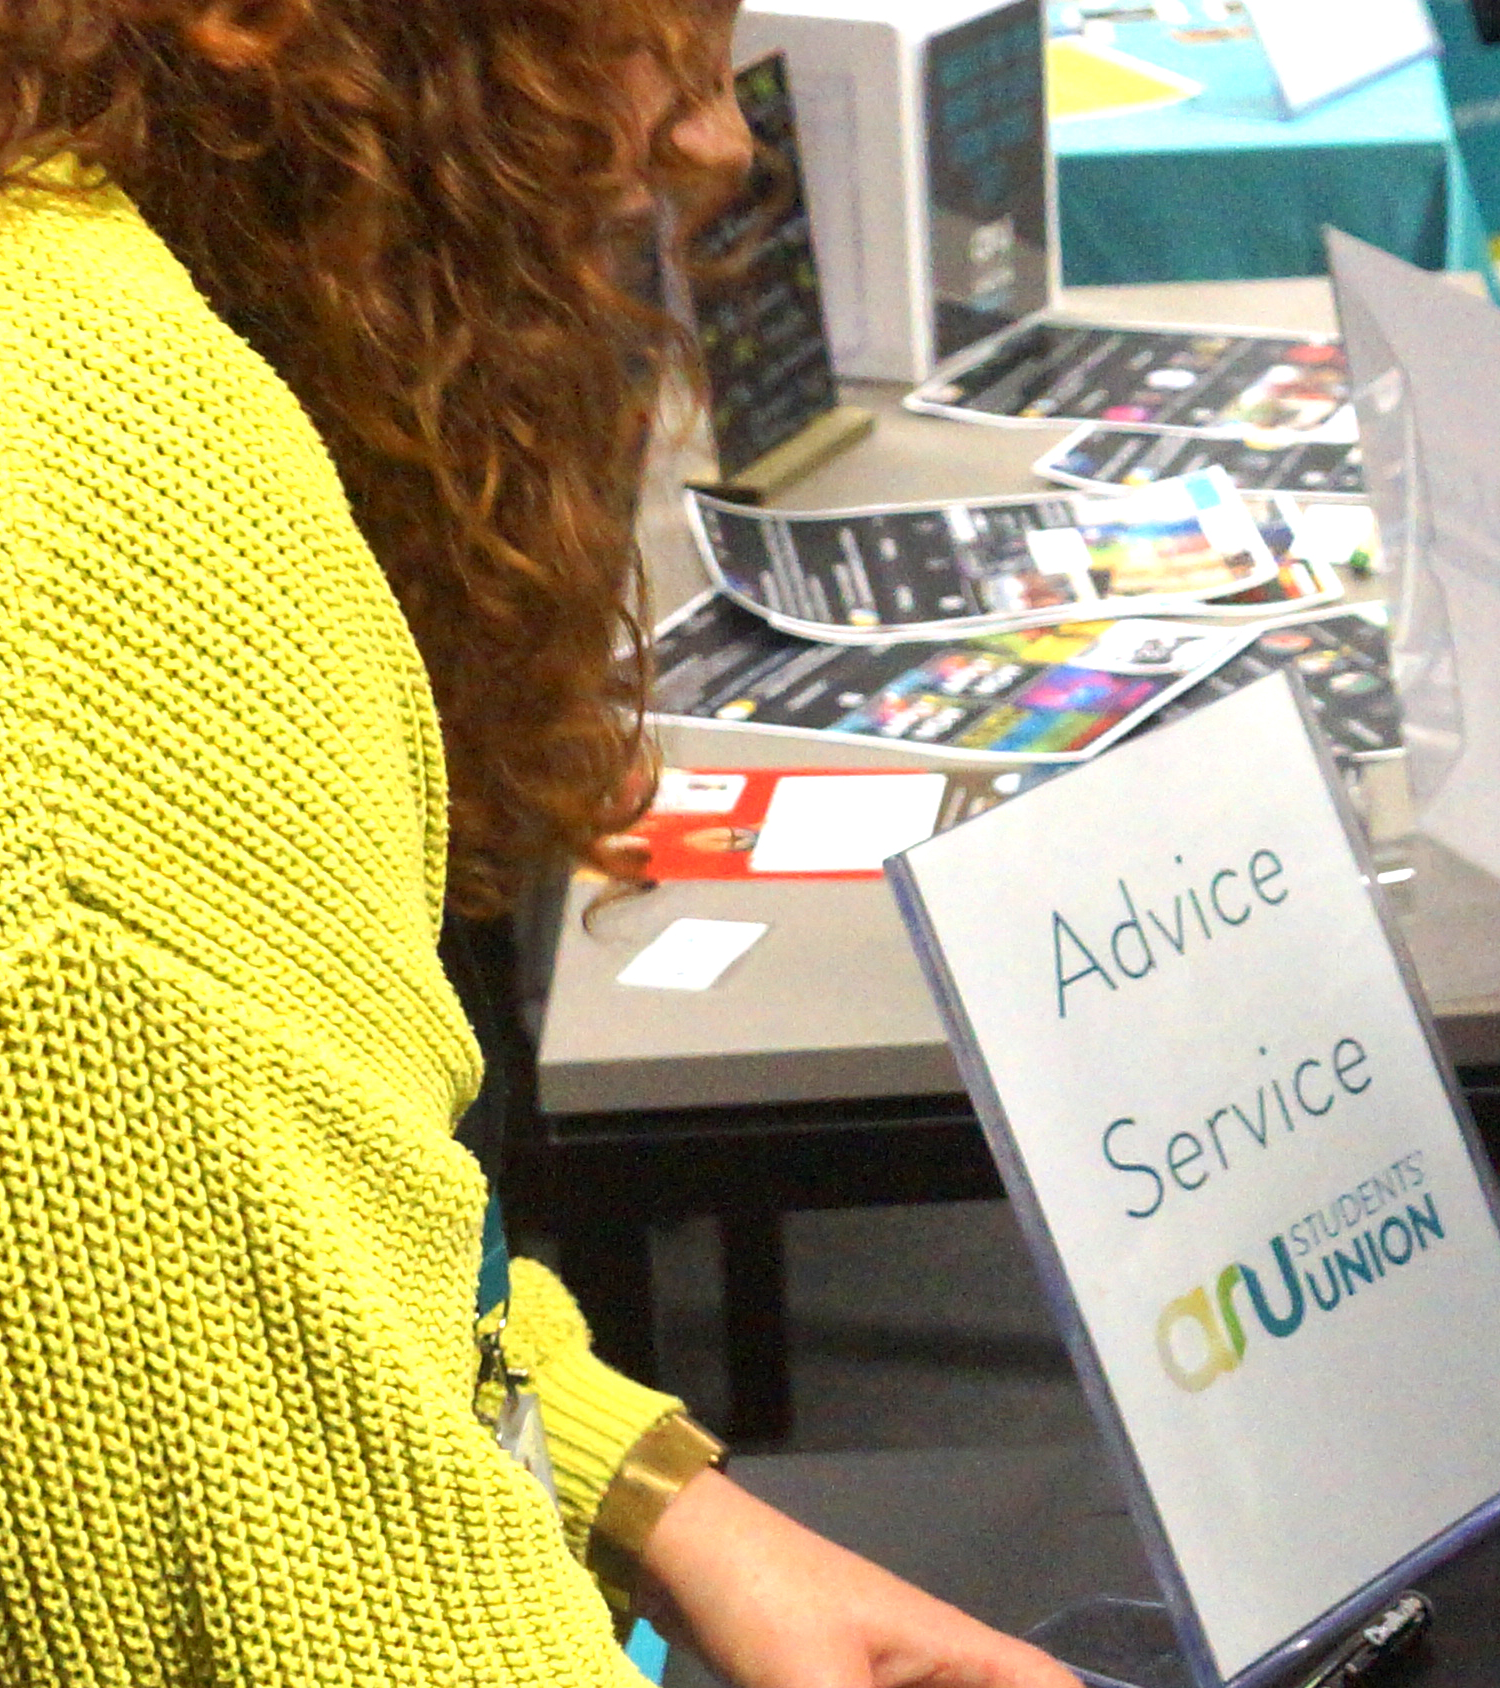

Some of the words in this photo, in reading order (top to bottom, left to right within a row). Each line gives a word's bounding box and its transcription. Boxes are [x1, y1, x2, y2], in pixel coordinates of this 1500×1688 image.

[1051, 847, 1290, 1019] Advice
[1102, 1037, 1373, 1219] Service
[1304, 1192, 1445, 1312] UNION
